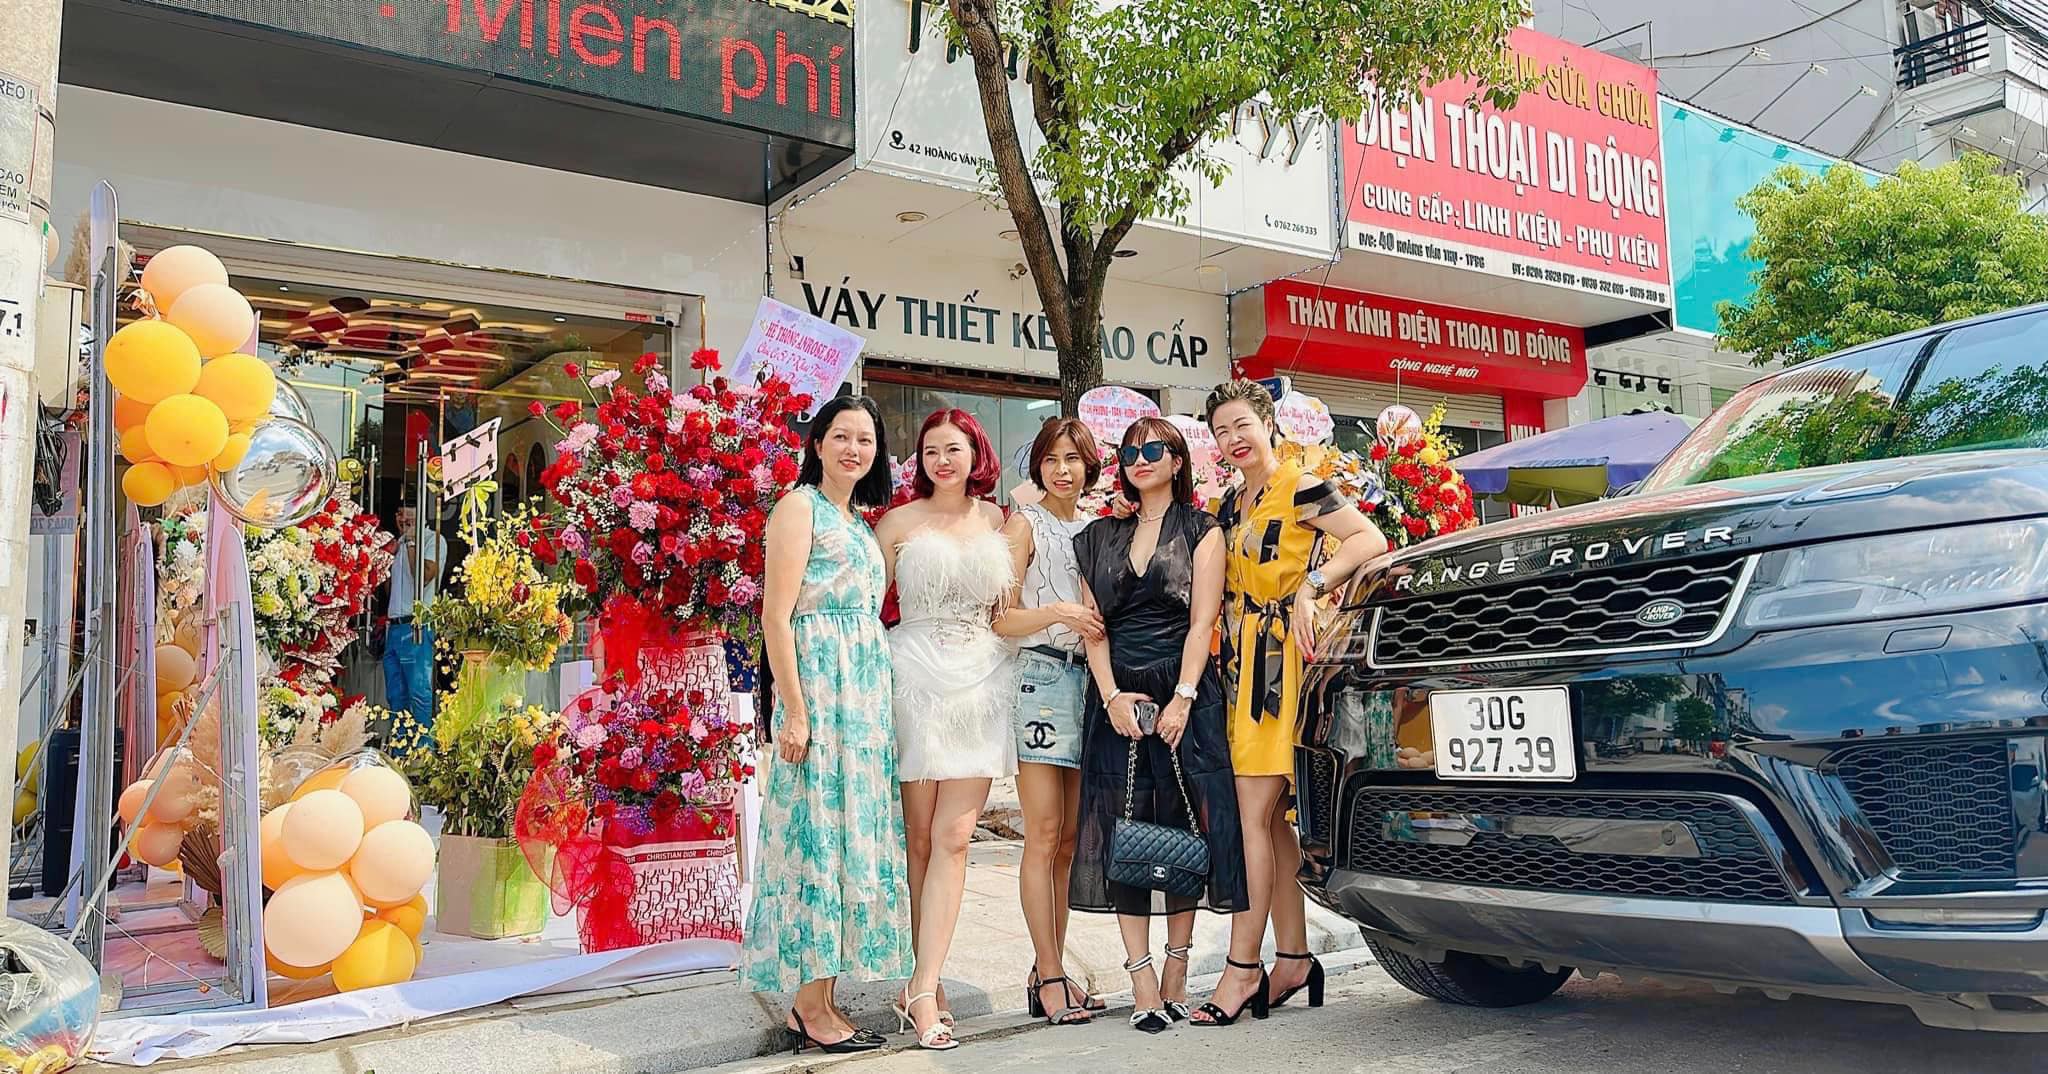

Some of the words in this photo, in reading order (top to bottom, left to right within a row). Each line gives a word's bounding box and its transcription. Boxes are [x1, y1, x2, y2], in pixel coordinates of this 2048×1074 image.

[720, 31, 846, 119] phí
[1545, 56, 1591, 110] SỬA
[1596, 81, 1653, 129] CHỮA
[908, 142, 921, 155] 42
[924, 145, 958, 162] HOÀNG
[978, 156, 993, 169] TH
[1444, 102, 1540, 196] THOẠI
[1545, 130, 1578, 198] DI
[1584, 136, 1661, 219] ĐỘNG
[1362, 182, 1413, 217] CUNG
[1463, 199, 1511, 237] LINH
[1516, 209, 1562, 251] KIỆN
[1575, 225, 1614, 265] PHỤ
[1618, 237, 1660, 272] KIỆN
[1378, 231, 1395, 251] 40
[800, 276, 887, 330] VÁY
[895, 289, 1001, 345] THIẾT
[1146, 318, 1208, 369] CẤP
[1286, 295, 1338, 331] THAY
[1344, 300, 1393, 339] KÍNH
[1398, 309, 1441, 349] ĐIỆN
[1445, 320, 1498, 358] THOẠI
[1503, 331, 1521, 357] DI
[1526, 327, 1572, 367] ĐỘNG
[1423, 362, 1455, 378] NGHỆ
[1395, 556, 1520, 592] RANGE
[1550, 525, 1734, 567] ROVER
[1467, 695, 1526, 731] 30G
[1449, 736, 1557, 773] 927.39
[646, 852, 682, 861] CHRISTIAN
